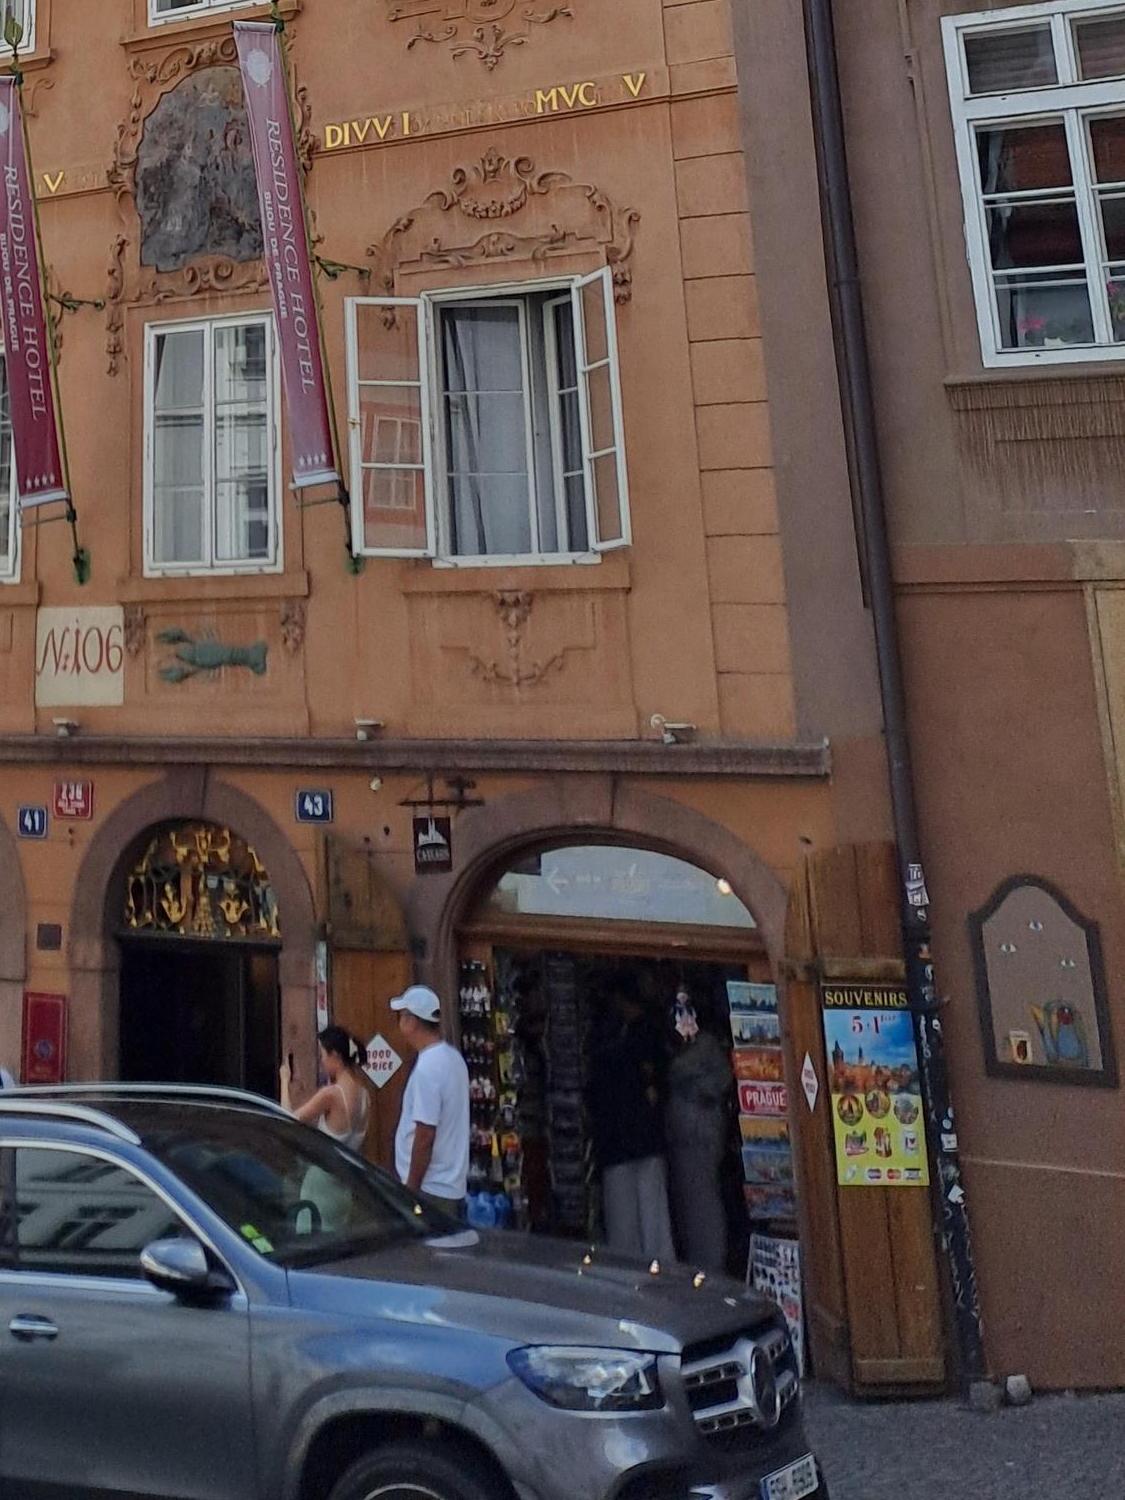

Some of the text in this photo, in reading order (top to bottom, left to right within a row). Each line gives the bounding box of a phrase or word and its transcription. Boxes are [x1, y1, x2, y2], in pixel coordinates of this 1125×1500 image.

[263, 191, 288, 319] BIJOU DE PRAGUE
[266, 117, 315, 395] RESIDENCE HOTEL
[0, 232, 20, 352] BIJOU DE PRAGUE
[3, 164, 47, 421] RESIDENCE HOTEL
[23, 809, 40, 832] 41
[304, 793, 324, 816] 43
[825, 990, 908, 1006] SOUVENIRS
[745, 1088, 788, 1107] PRAGUE
